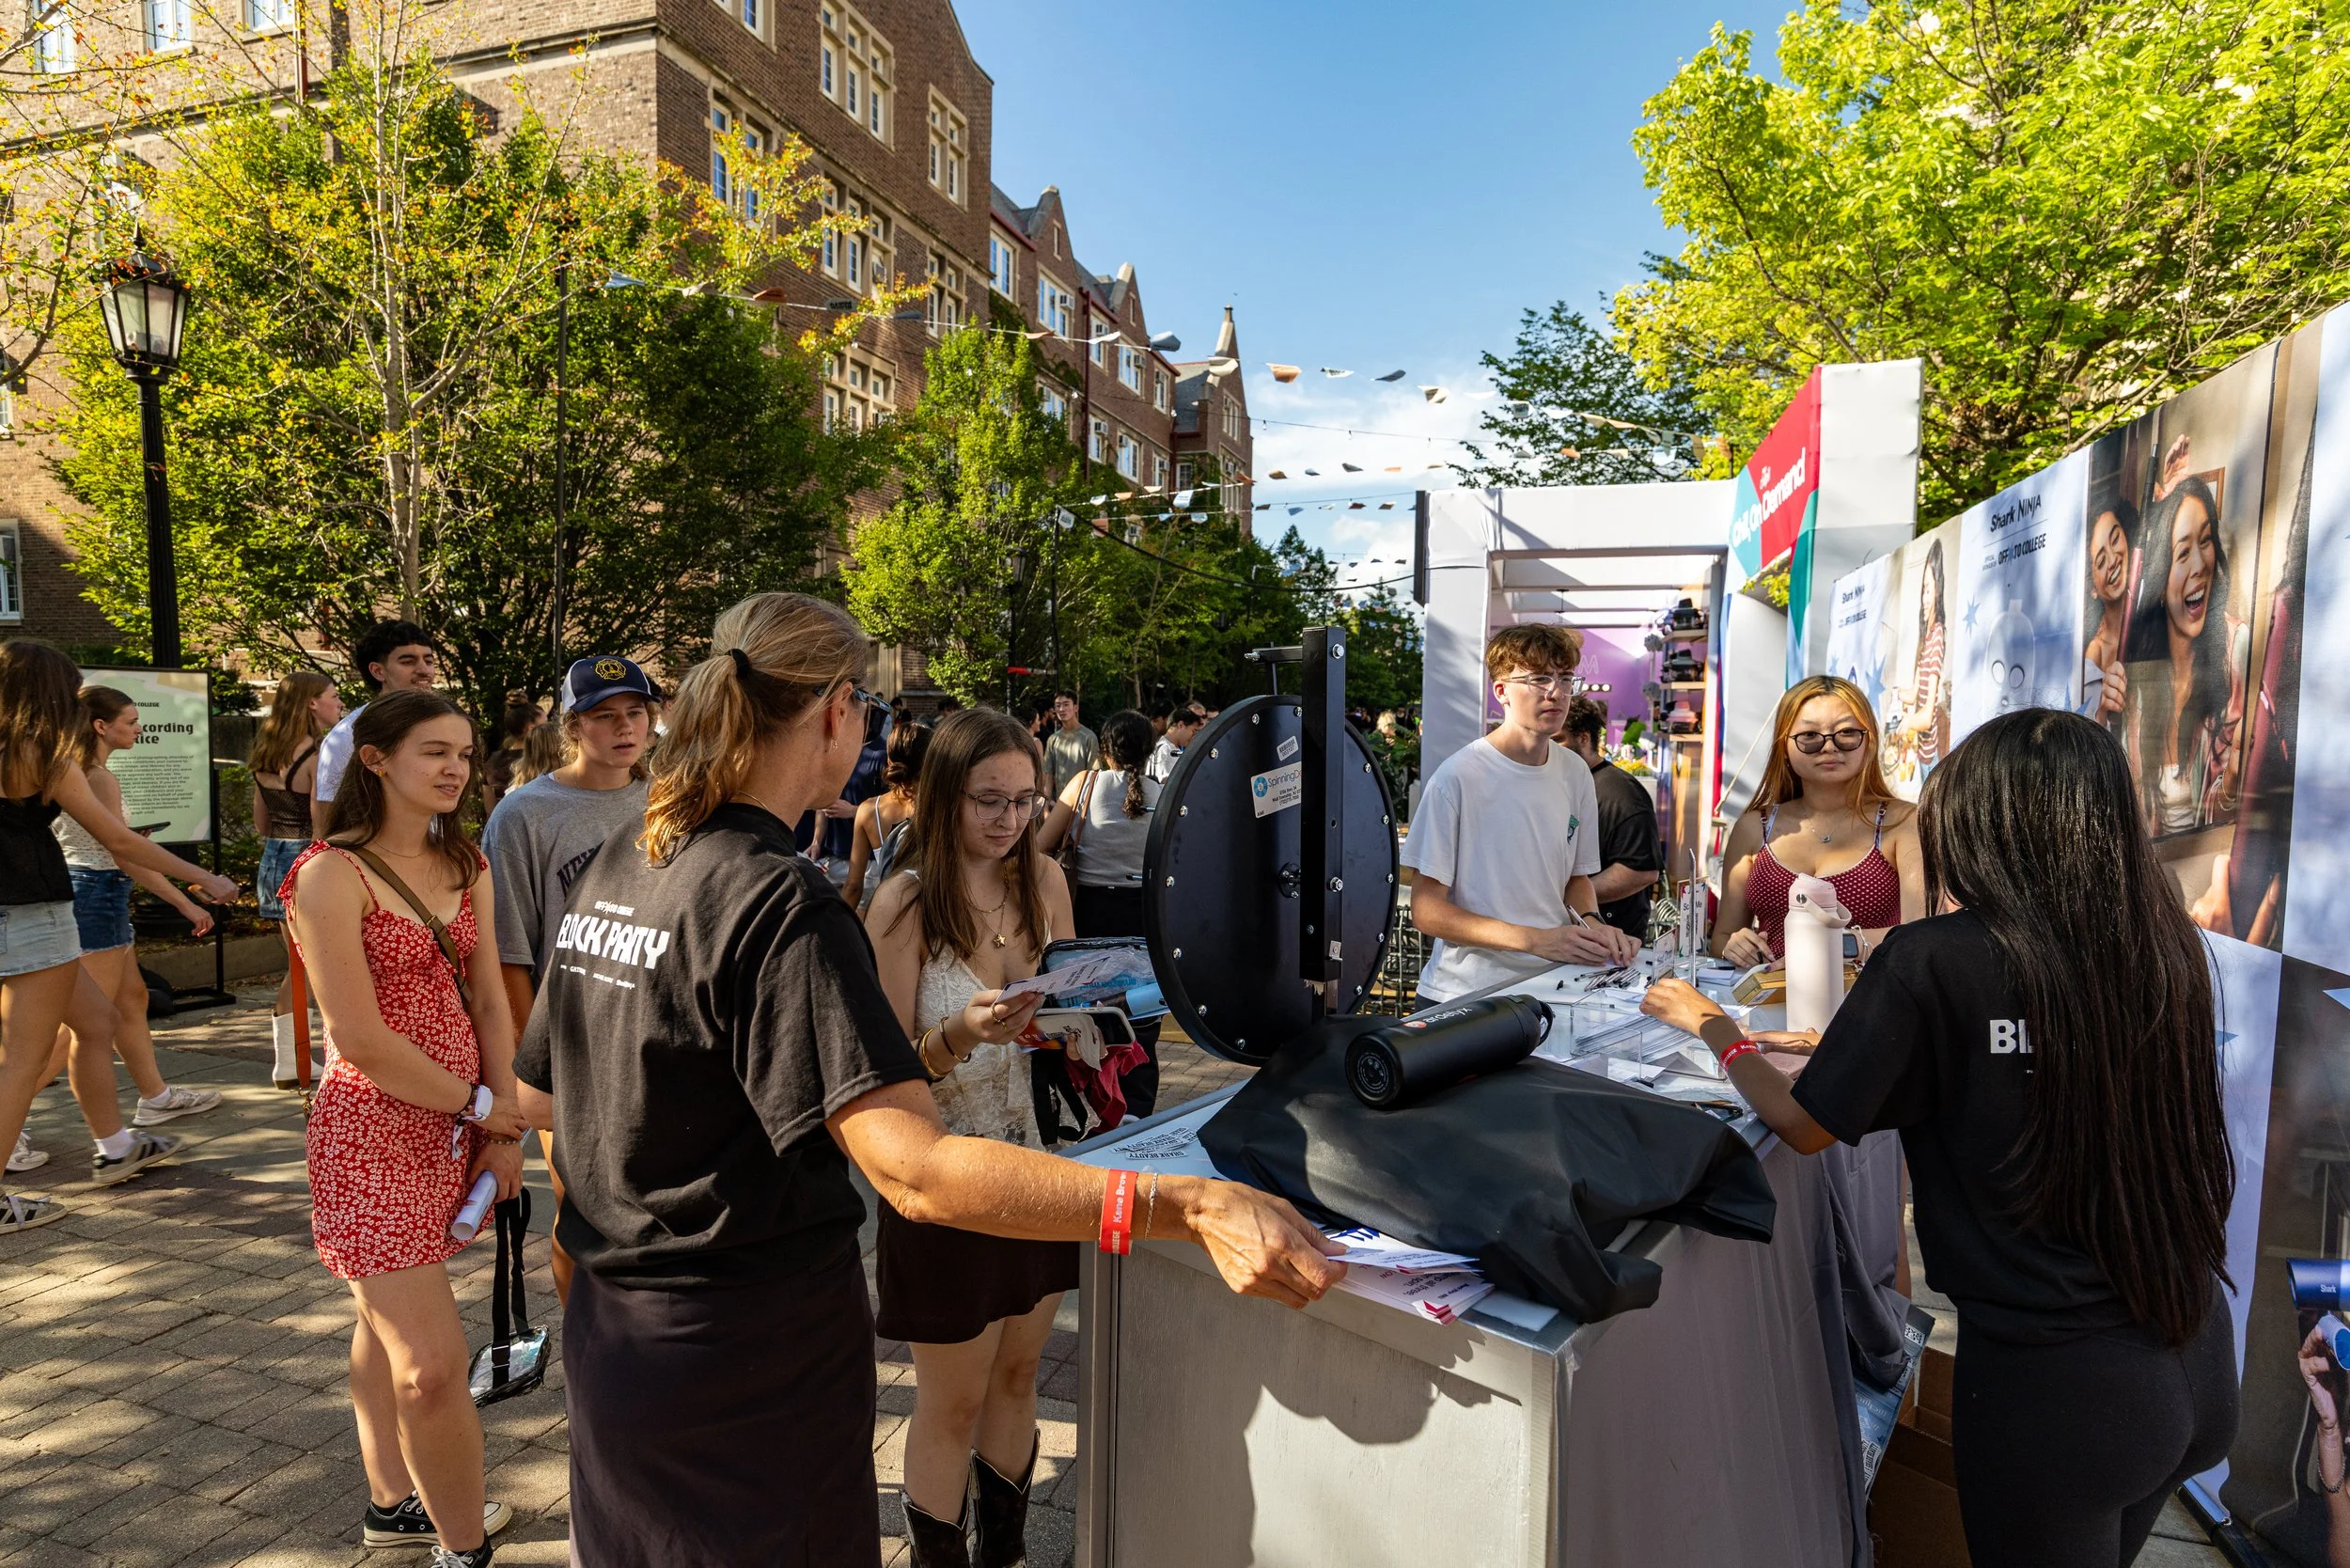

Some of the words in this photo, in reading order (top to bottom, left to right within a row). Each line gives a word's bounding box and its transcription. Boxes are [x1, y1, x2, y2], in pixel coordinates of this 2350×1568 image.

[1762, 446, 1806, 522] Demand
[1990, 506, 2016, 533] Shark
[2017, 494, 2042, 523] NINJA
[1998, 548, 2009, 565] OFF
[2013, 542, 2022, 559] TO
[2022, 533, 2046, 557] COLLEGE
[135, 734, 160, 744] tice
[142, 723, 194, 735] cording
[1268, 769, 1302, 789] SpinningD
[2320, 1284, 2336, 1293] Shark
